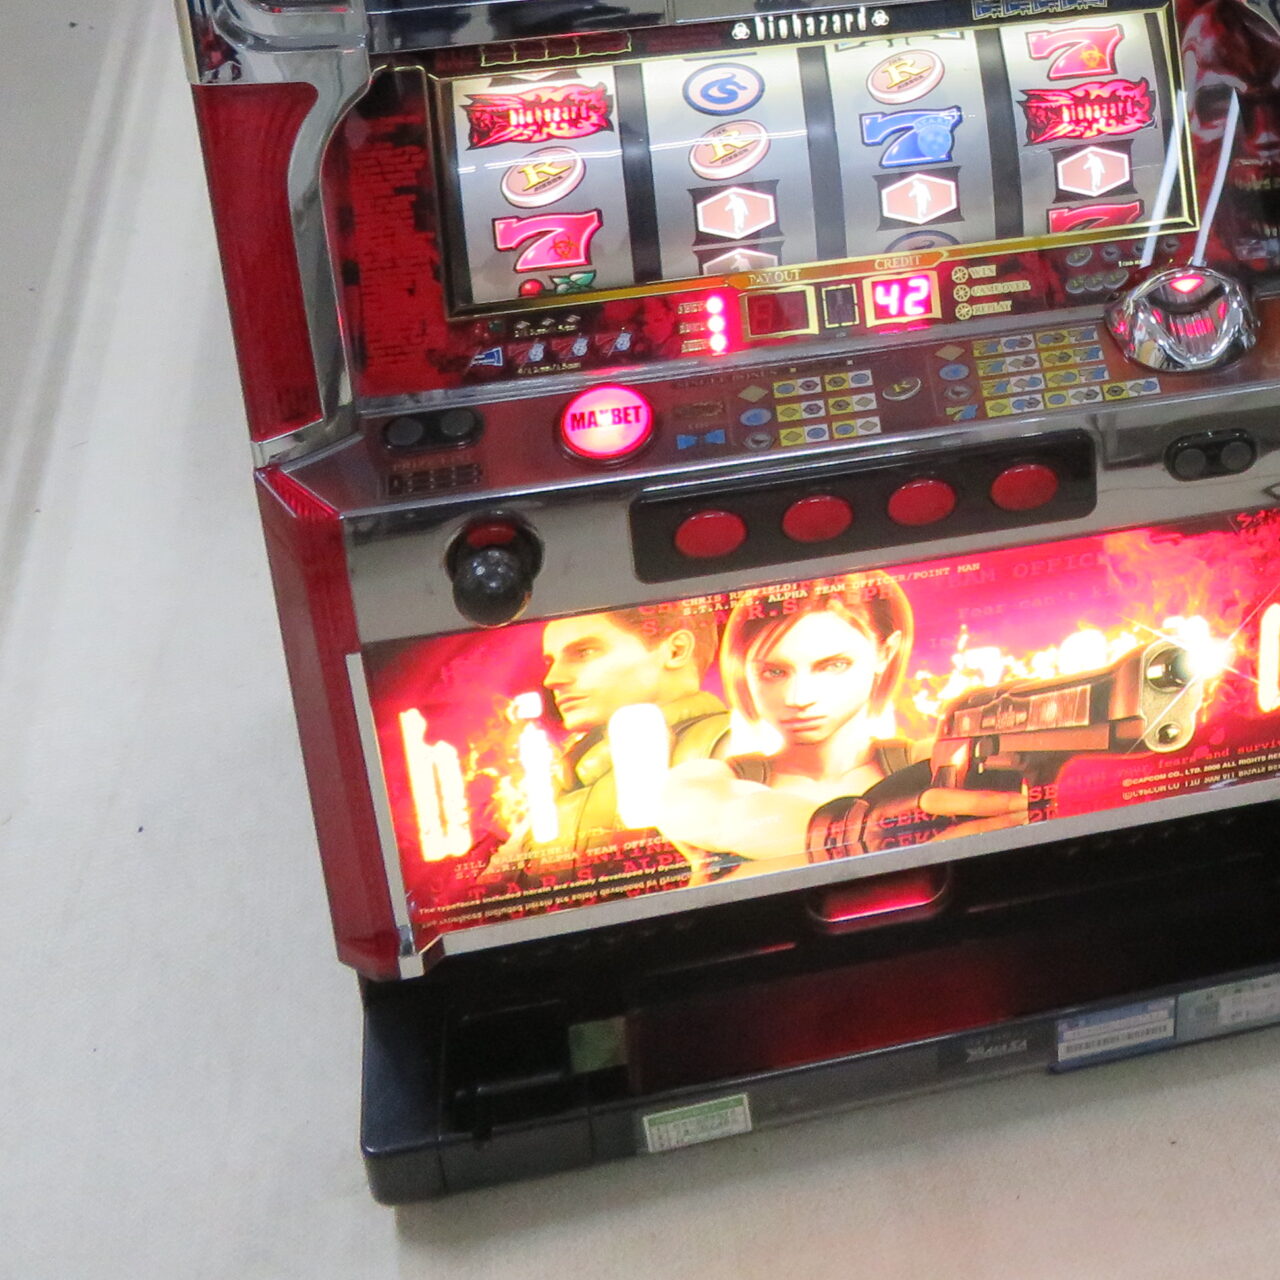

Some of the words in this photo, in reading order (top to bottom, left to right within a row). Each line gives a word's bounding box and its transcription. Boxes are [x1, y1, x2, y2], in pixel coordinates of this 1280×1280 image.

[755, 7, 866, 41] biohazard
[1027, 24, 1125, 80] 7
[859, 105, 963, 168] 7
[492, 208, 603, 273] 7
[874, 254, 923, 271] CREDIT
[874, 274, 931, 317] 42
[571, 404, 642, 431] MABET
[681, 593, 724, 607] CHRIS
[730, 583, 798, 601] REDFIELD:
[768, 588, 808, 604] ALPHA
[815, 582, 846, 597] TEAM
[958, 563, 980, 573] MAN
[1185, 767, 1202, 777] LTD.
[1221, 759, 1237, 769] ALL
[1238, 755, 1267, 766] RIGHTS
[1206, 748, 1230, 760] and
[539, 851, 579, 864] ALPHA
[587, 844, 617, 856] TEAM
[623, 836, 670, 849] OFFIC
[455, 861, 485, 871] JILL
[419, 906, 436, 916] The
[437, 898, 481, 914] typefaces
[482, 892, 521, 906] included
[523, 886, 552, 897] herein
[553, 883, 567, 893] are
[569, 878, 595, 890] solely
[597, 870, 644, 886] developed
[645, 867, 655, 877] by
